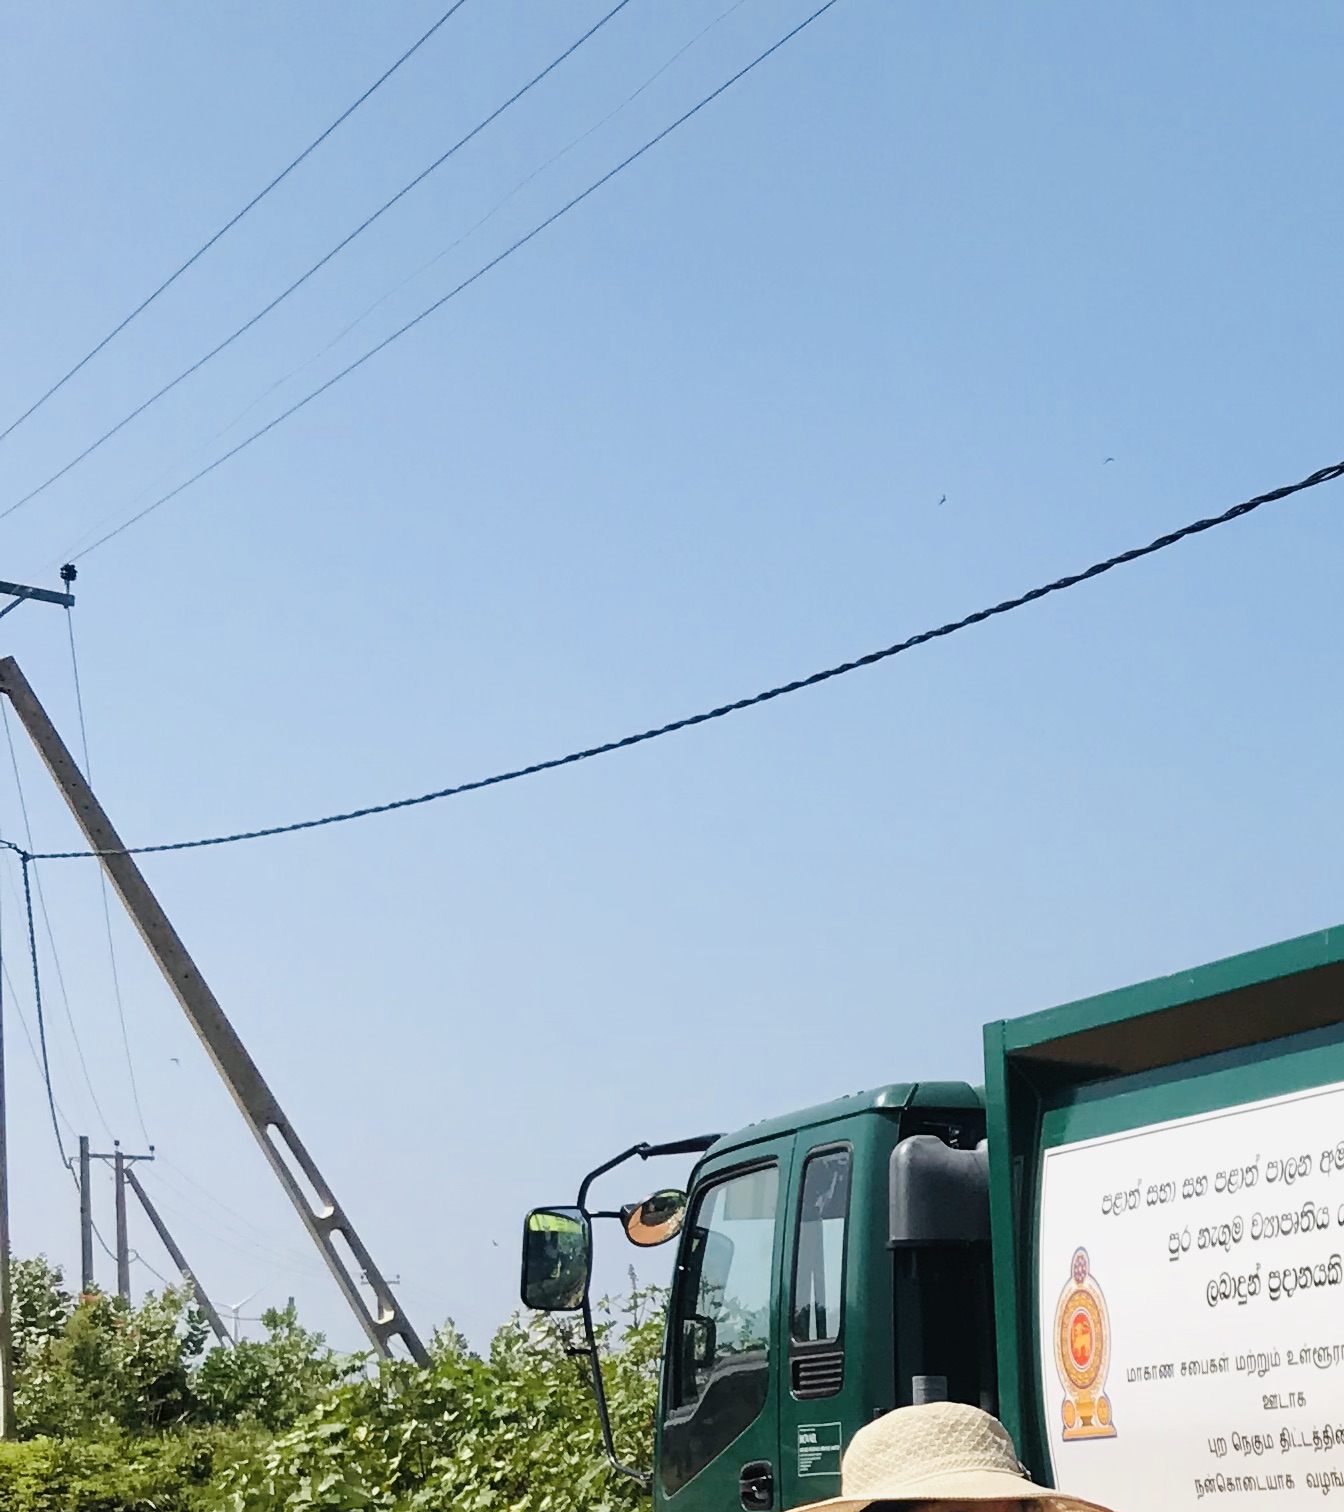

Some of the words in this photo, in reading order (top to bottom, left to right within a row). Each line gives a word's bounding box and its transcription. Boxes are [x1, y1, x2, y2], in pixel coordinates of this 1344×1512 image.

[1102, 1179, 1142, 1216] පළාත්
[1147, 1181, 1176, 1206] සභා
[1182, 1175, 1208, 1198] සහ
[1215, 1154, 1260, 1194] පළාත්
[1266, 1154, 1312, 1185] පාලන
[1169, 1226, 1191, 1262] පුර
[1198, 1216, 1243, 1253] නැගුම
[1206, 1263, 1261, 1308] ලබාදුන්
[1127, 1364, 1174, 1382] மாகாண
[1181, 1357, 1229, 1376] சபைகள்
[1236, 1352, 1280, 1377] மற்றும்
[1262, 1392, 1306, 1410] ஊடாக
[1208, 1437, 1227, 1457] புற
